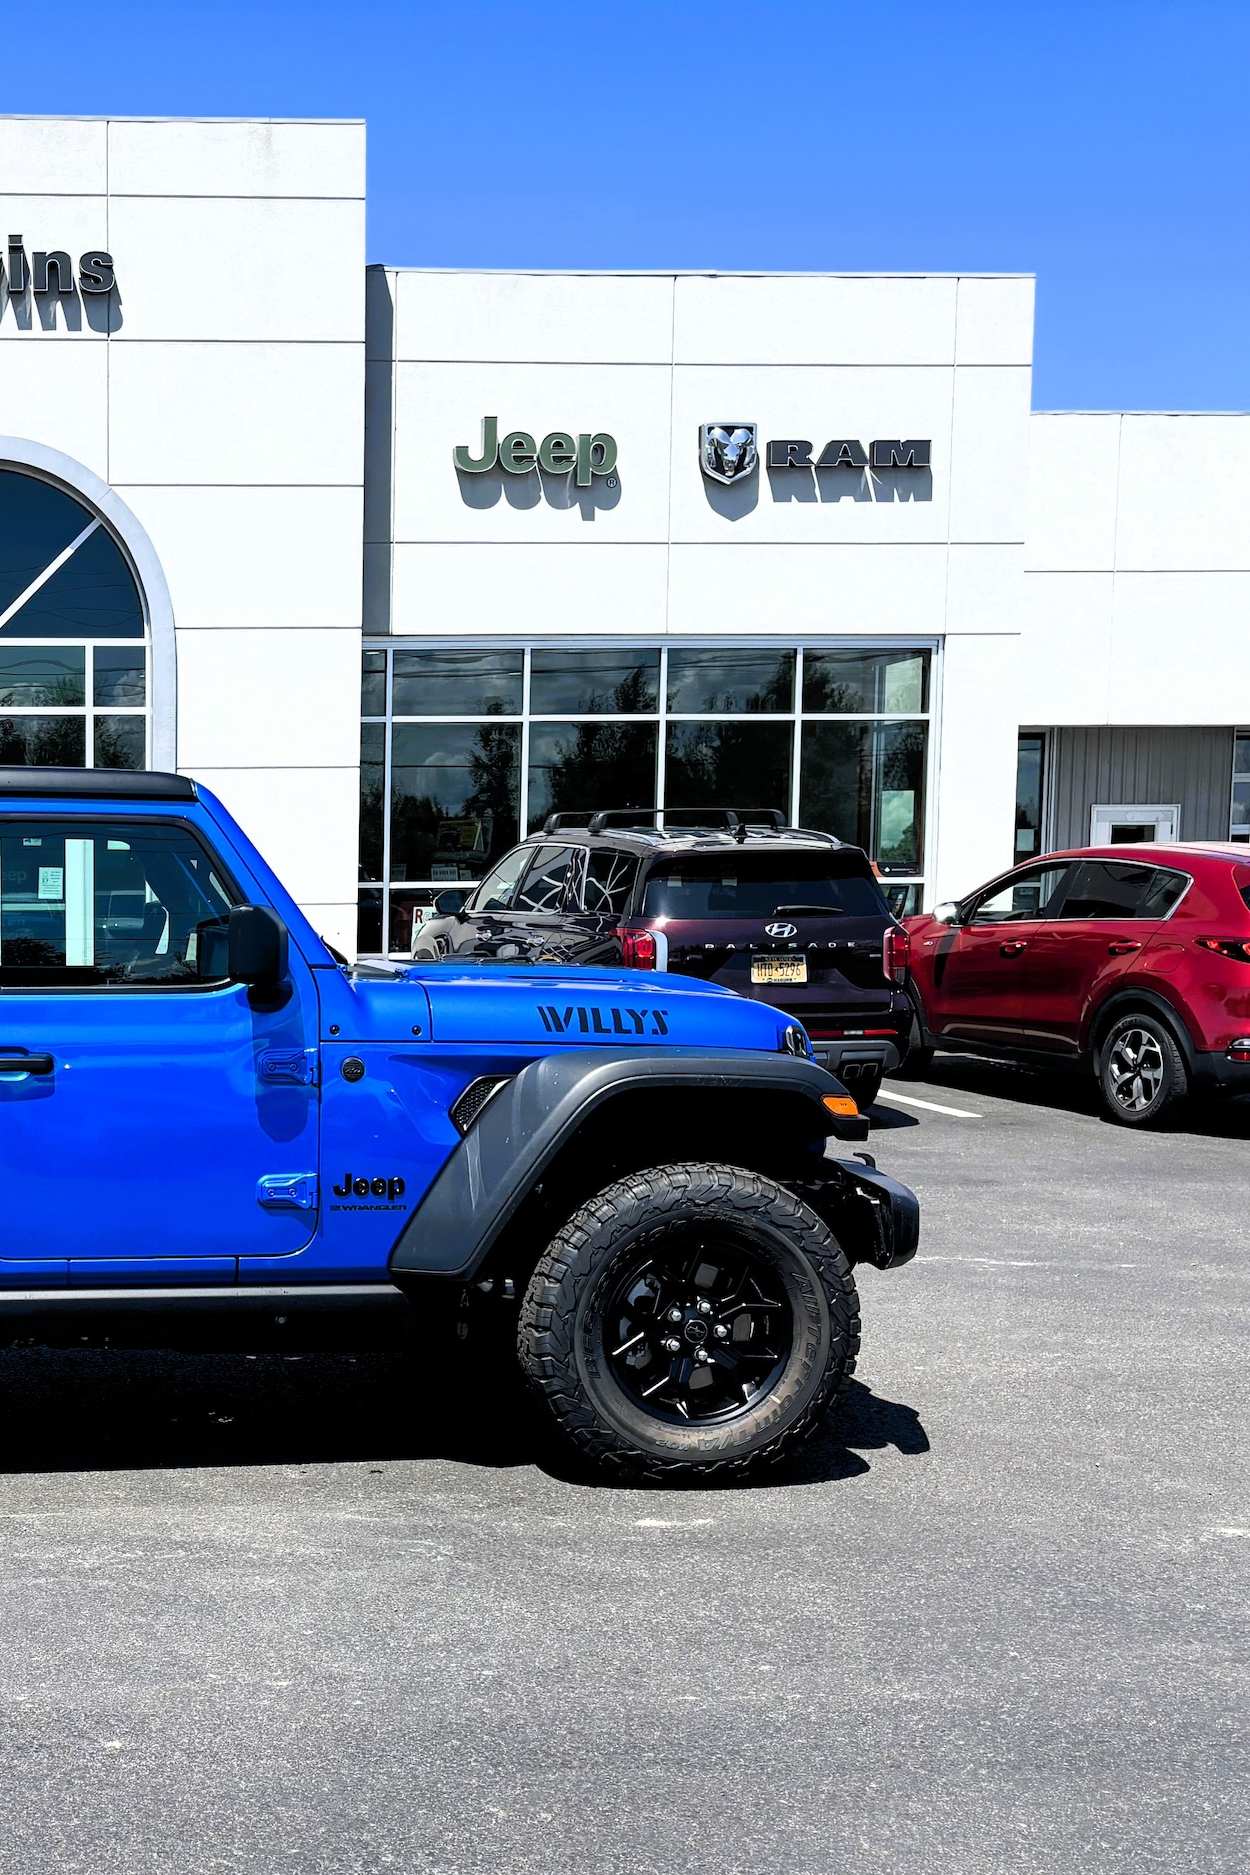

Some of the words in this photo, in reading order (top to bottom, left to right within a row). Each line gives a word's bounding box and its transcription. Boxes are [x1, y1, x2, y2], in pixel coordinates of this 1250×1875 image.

[452, 416, 620, 487] Jeep
[766, 440, 932, 468] RAM
[779, 962, 801, 977] 5296
[536, 1006, 669, 1035] WILLYS
[333, 1173, 405, 1202] Jeep
